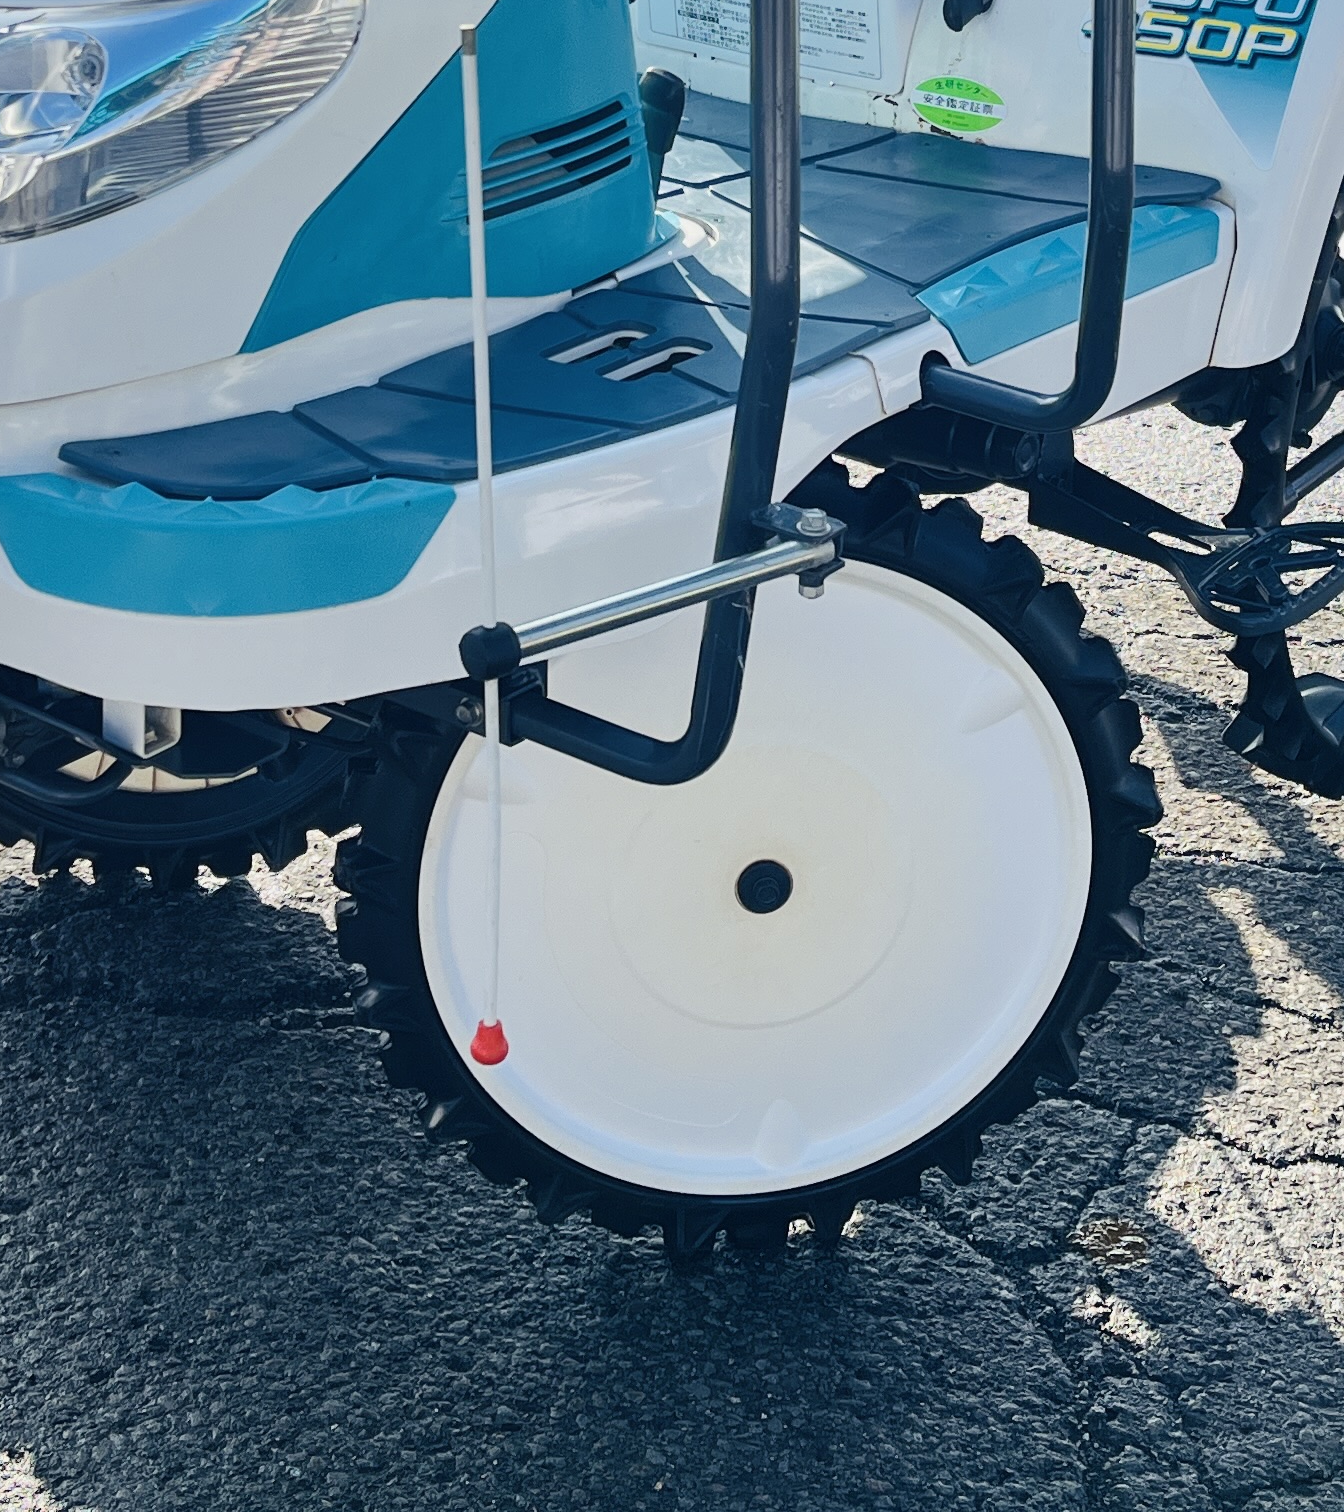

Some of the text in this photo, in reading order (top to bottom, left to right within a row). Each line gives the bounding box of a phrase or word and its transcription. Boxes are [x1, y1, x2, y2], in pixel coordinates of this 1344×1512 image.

[1082, 8, 1300, 66] 50P
[934, 79, 989, 98] 生研センター
[922, 93, 994, 116] 安全鑑定証票
